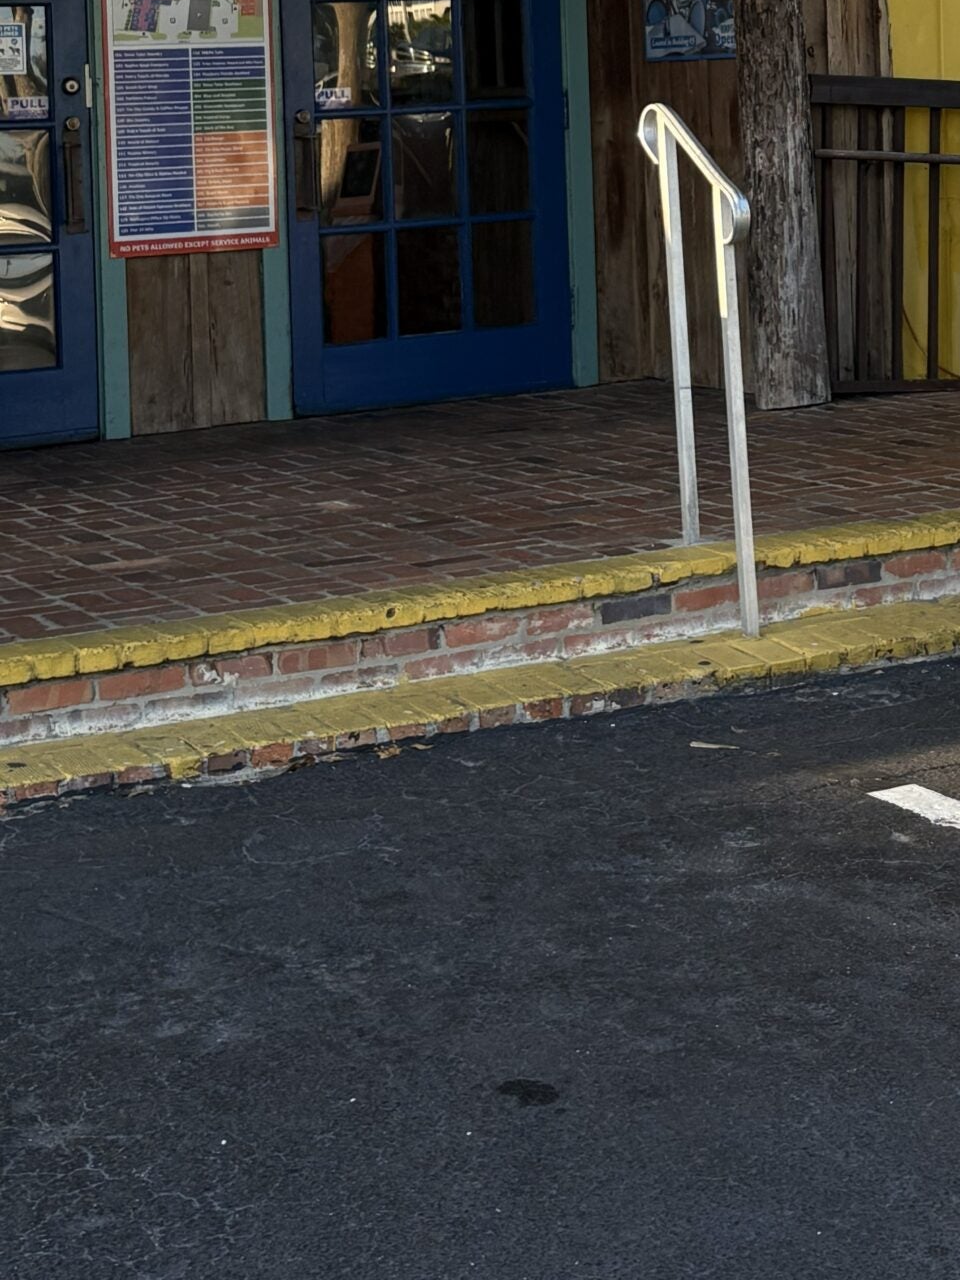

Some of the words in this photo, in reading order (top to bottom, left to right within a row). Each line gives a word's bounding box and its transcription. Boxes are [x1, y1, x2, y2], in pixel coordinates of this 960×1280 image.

[317, 89, 350, 99] PULL
[11, 98, 46, 109] PULL
[151, 242, 183, 250] ALLOWED
[184, 240, 210, 248] EXCEPT
[211, 238, 239, 247] SERVICE
[240, 236, 270, 244] ANIMALS
